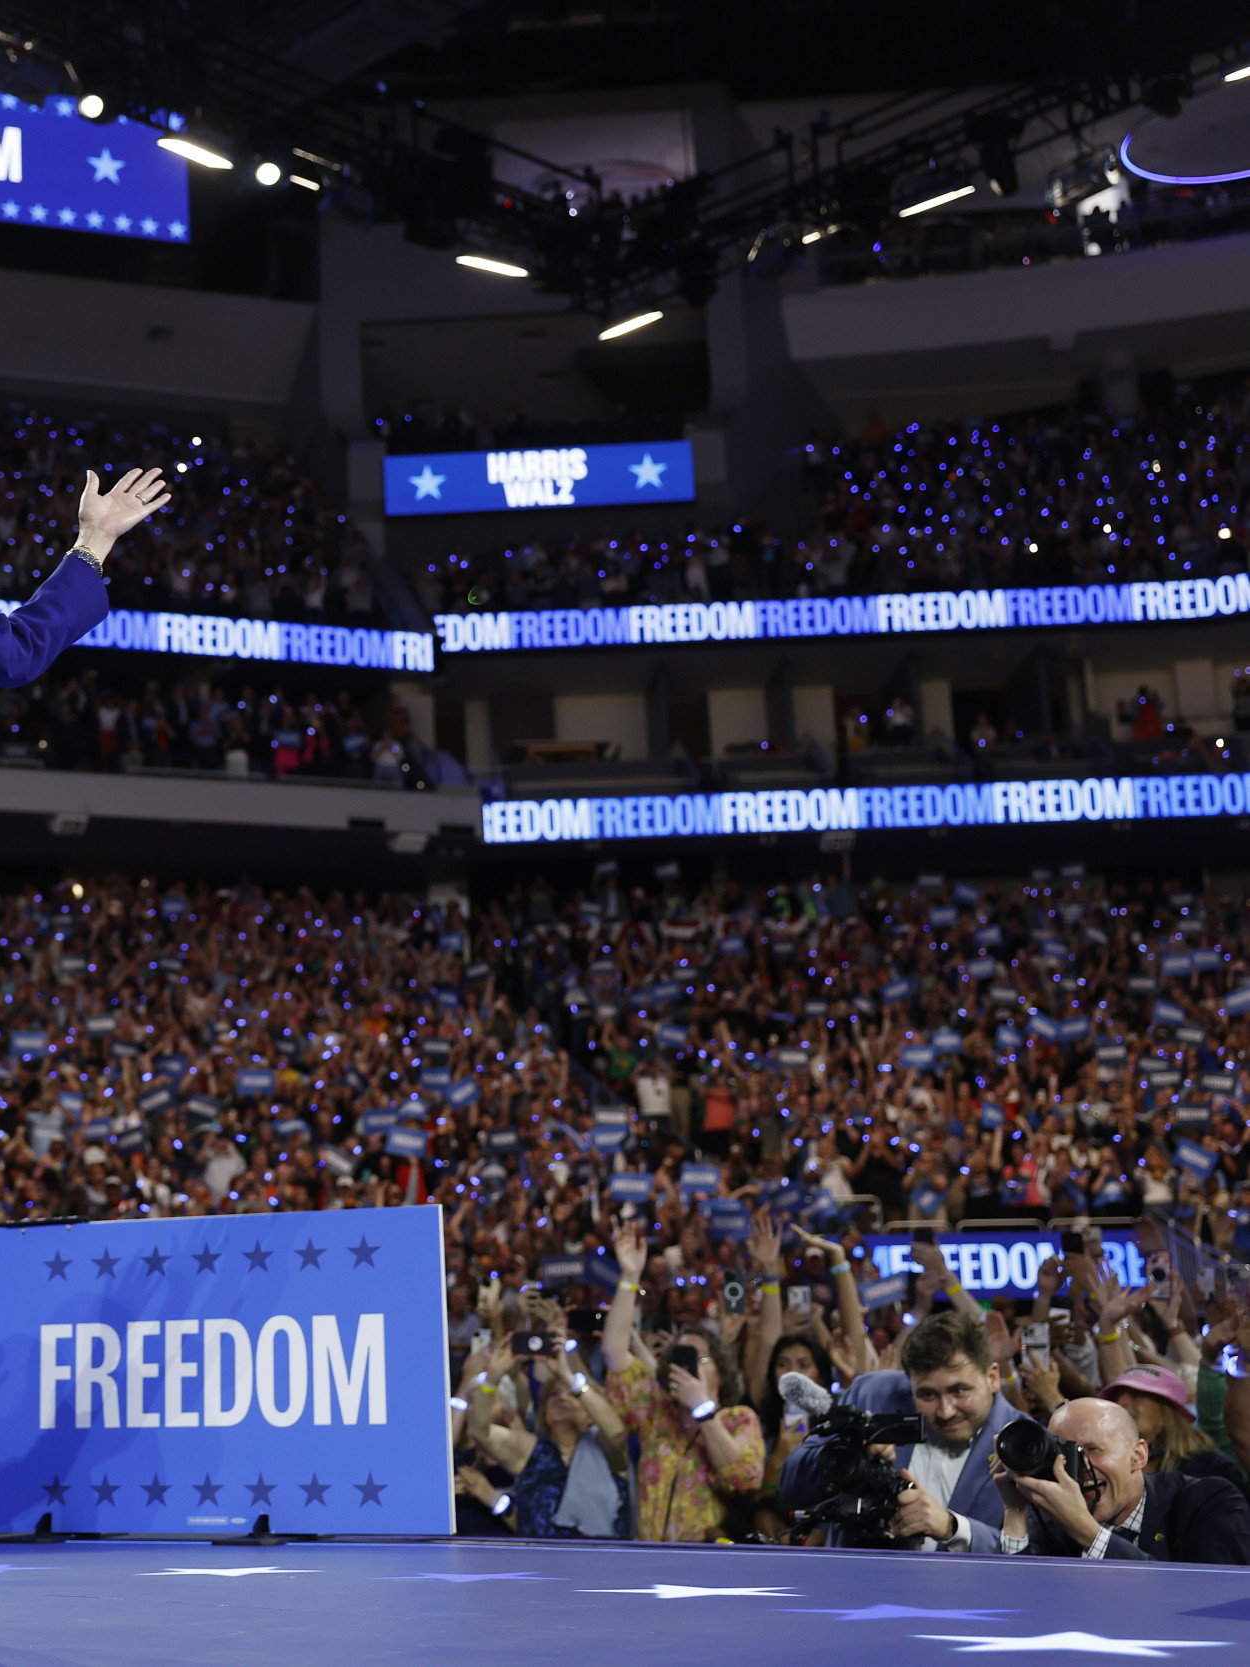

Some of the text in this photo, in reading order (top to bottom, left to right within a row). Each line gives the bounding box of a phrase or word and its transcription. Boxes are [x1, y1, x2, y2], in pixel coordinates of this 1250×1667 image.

[486, 448, 589, 484] HARRIS
[502, 477, 576, 508] WALZ
[157, 612, 280, 660] FREEDOM
[279, 622, 394, 668] FREEDOM
[510, 607, 630, 648] FREEDOM
[629, 601, 755, 643] FREEDOM
[755, 594, 878, 637] FREEDOM
[878, 589, 1007, 632] FREEDOM
[1006, 583, 1132, 627] FREEDOM
[482, 798, 591, 843] EEDOM
[590, 793, 723, 839] FREEDOM
[721, 787, 859, 834] FREEDOM
[858, 783, 993, 829] FREEDOM
[992, 777, 1134, 824] FREEDOM
[39, 1312, 388, 1430] FREEDOM
